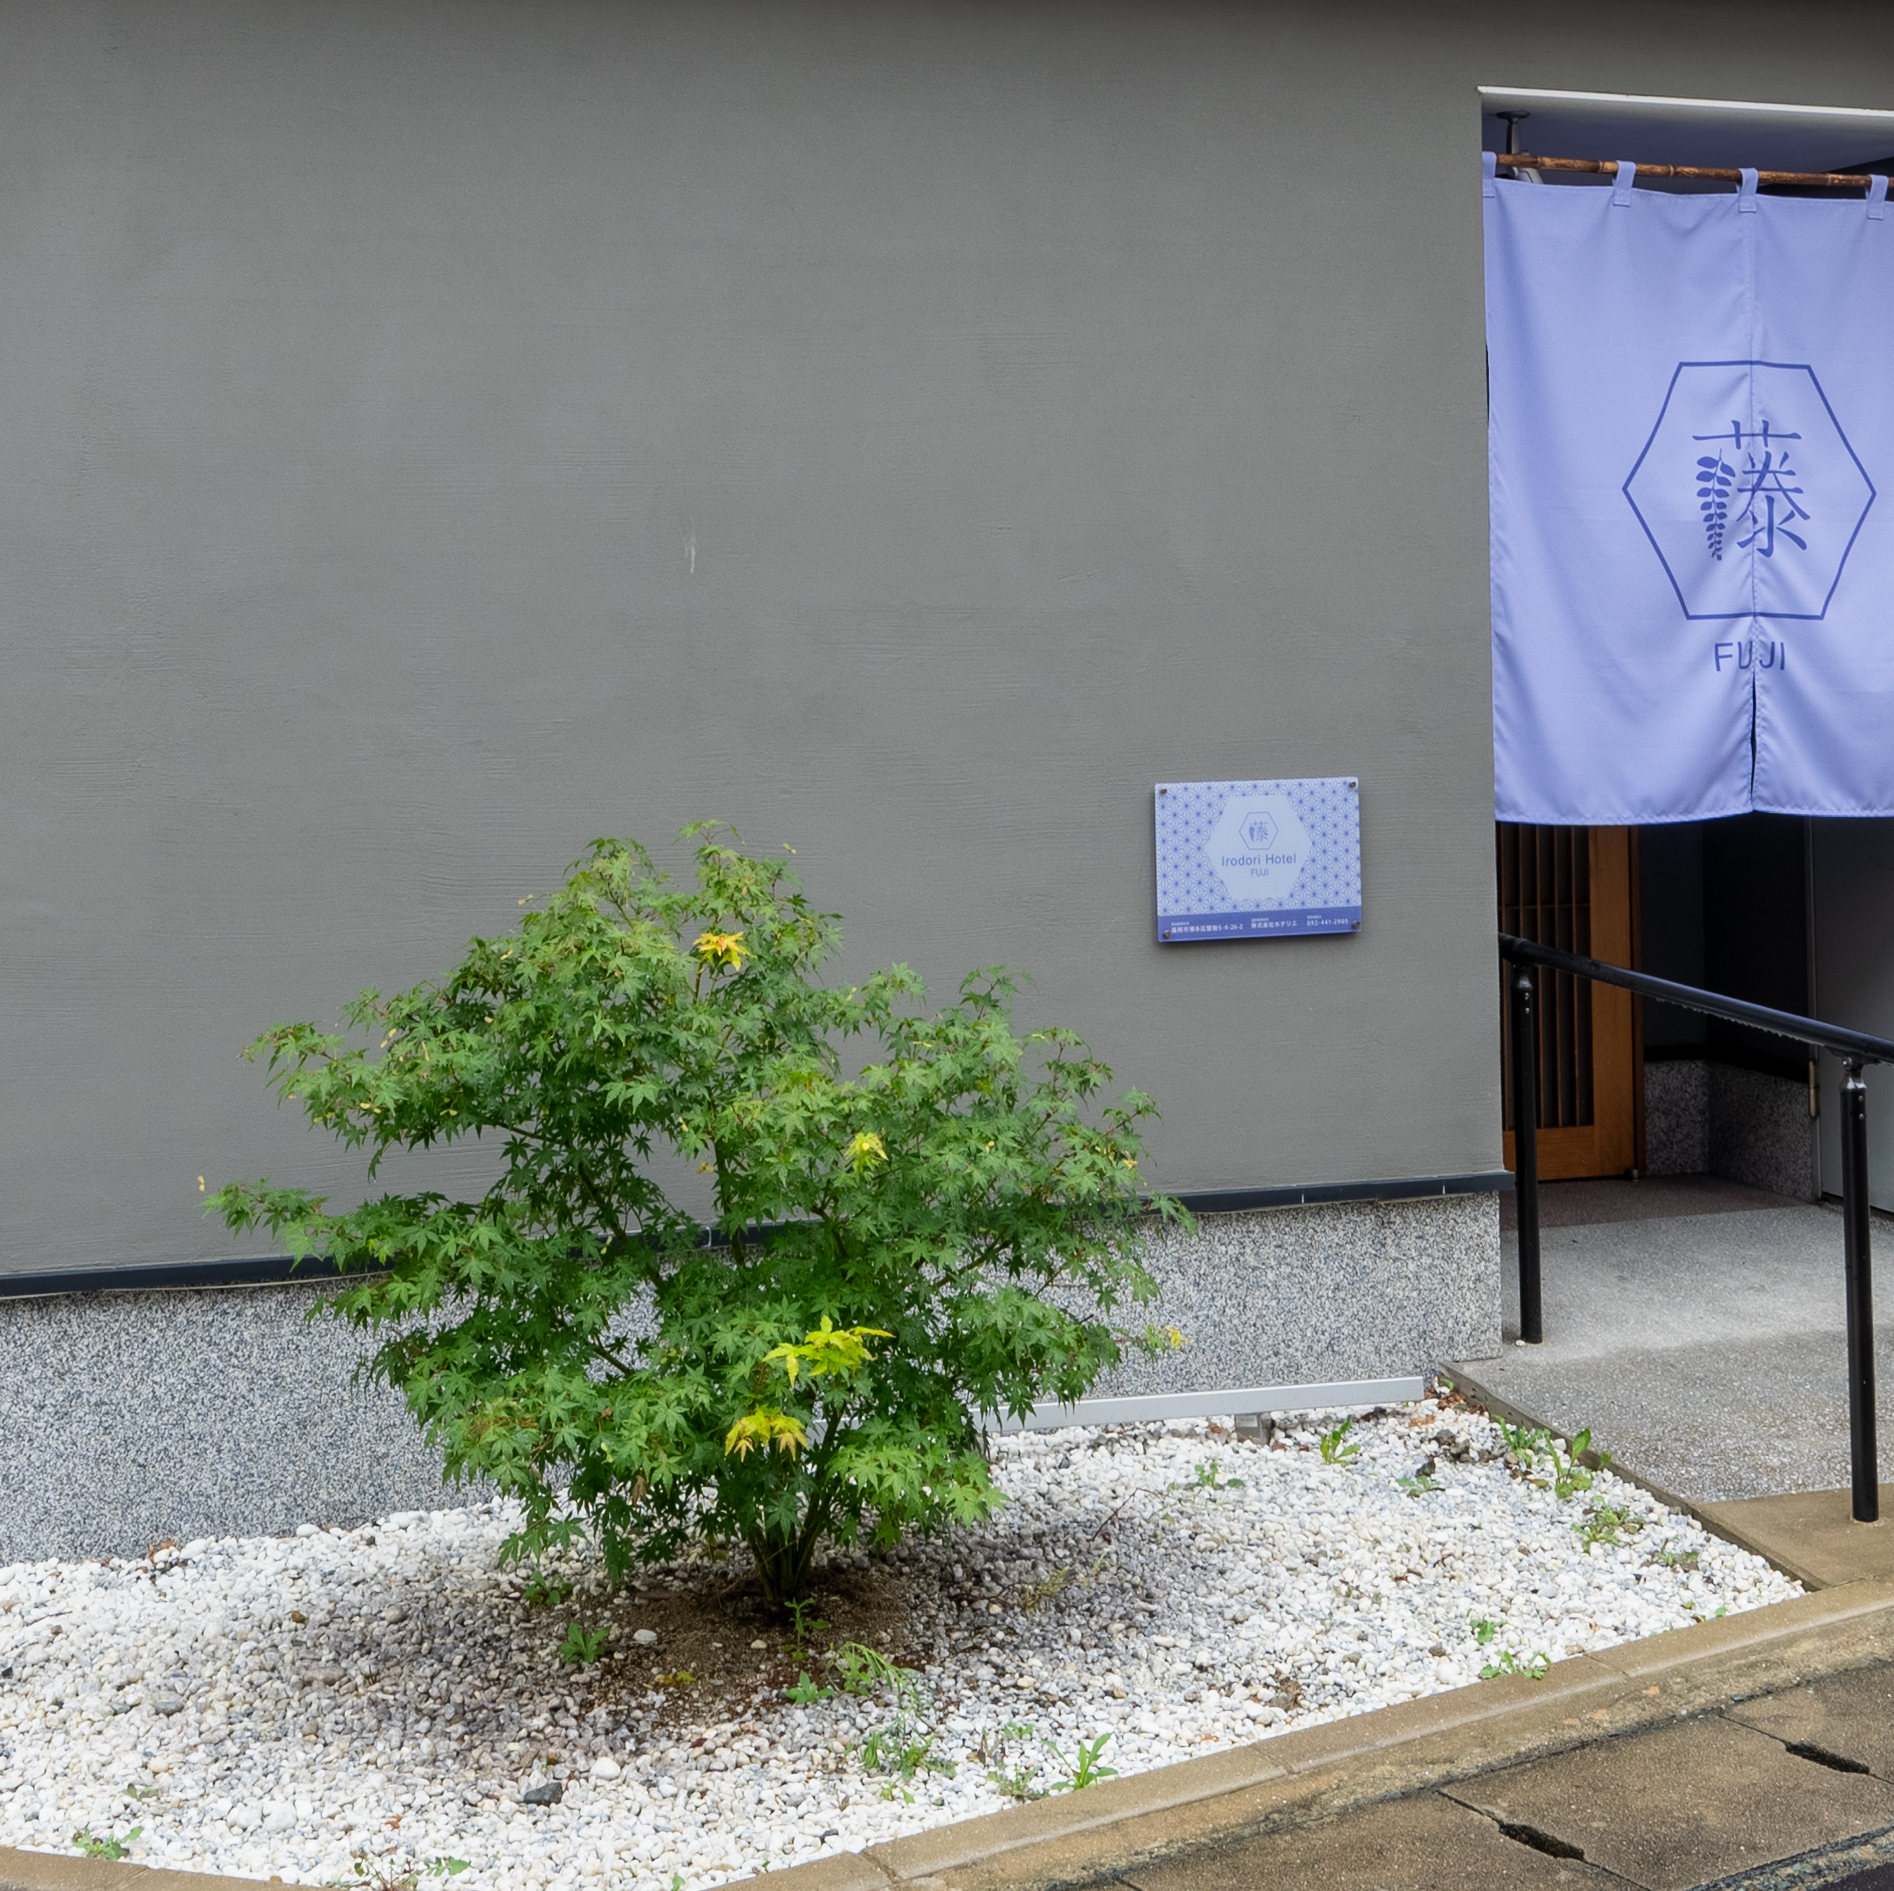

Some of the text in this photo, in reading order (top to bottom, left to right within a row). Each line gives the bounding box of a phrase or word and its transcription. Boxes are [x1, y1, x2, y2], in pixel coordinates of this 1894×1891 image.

[1714, 641, 1785, 672] FUJI
[1221, 853, 1296, 867] Irodori Hotel
[1250, 868, 1269, 877] FUJI
